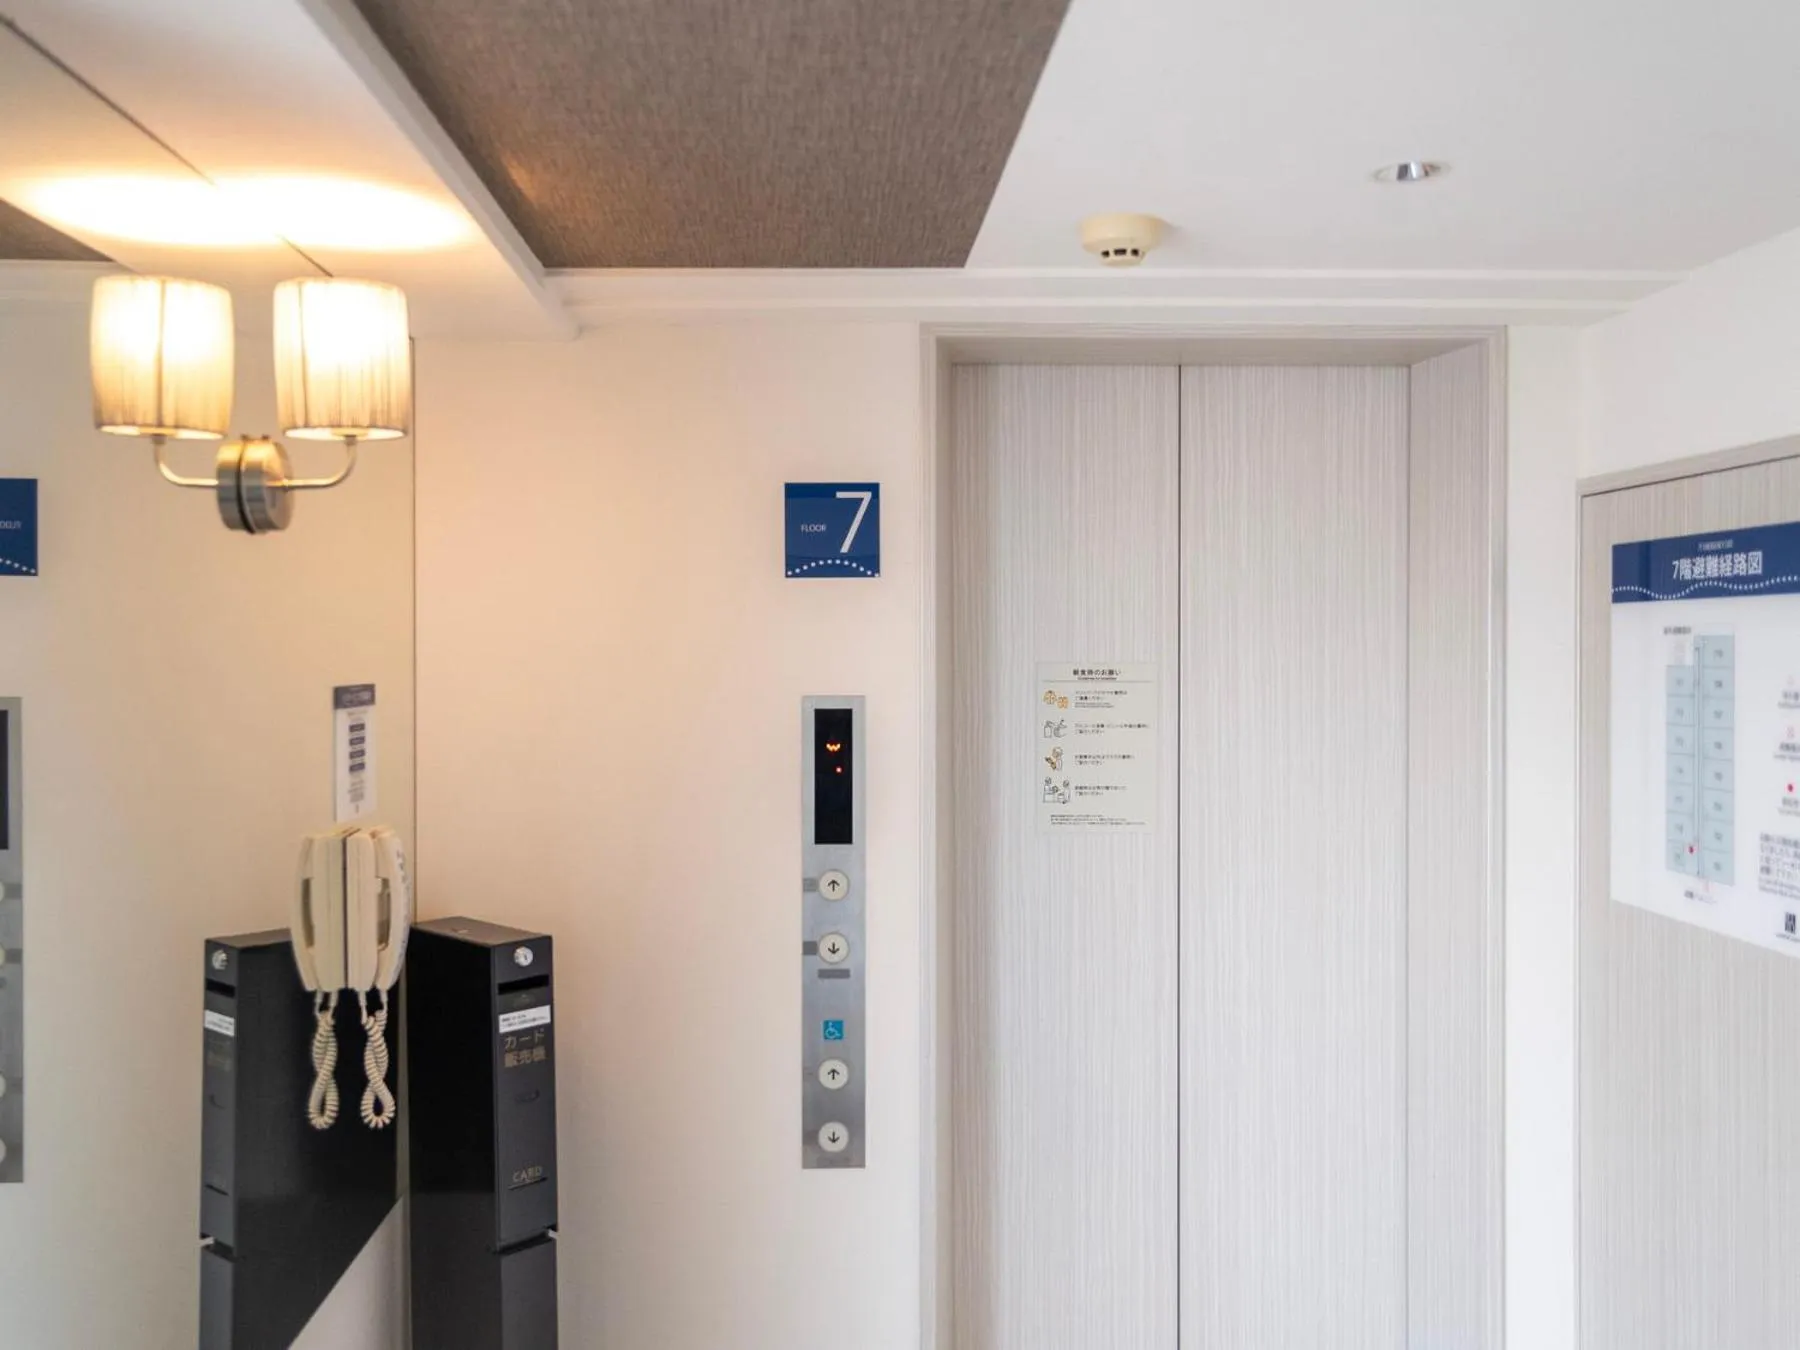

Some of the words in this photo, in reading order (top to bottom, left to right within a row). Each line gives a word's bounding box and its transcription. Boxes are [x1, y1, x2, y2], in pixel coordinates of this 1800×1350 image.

[801, 524, 826, 532] FLOOR
[836, 491, 871, 553] 7
[1672, 551, 1763, 580] 7階避難経路図
[504, 1028, 545, 1050] カード
[512, 1166, 543, 1182] CARD
